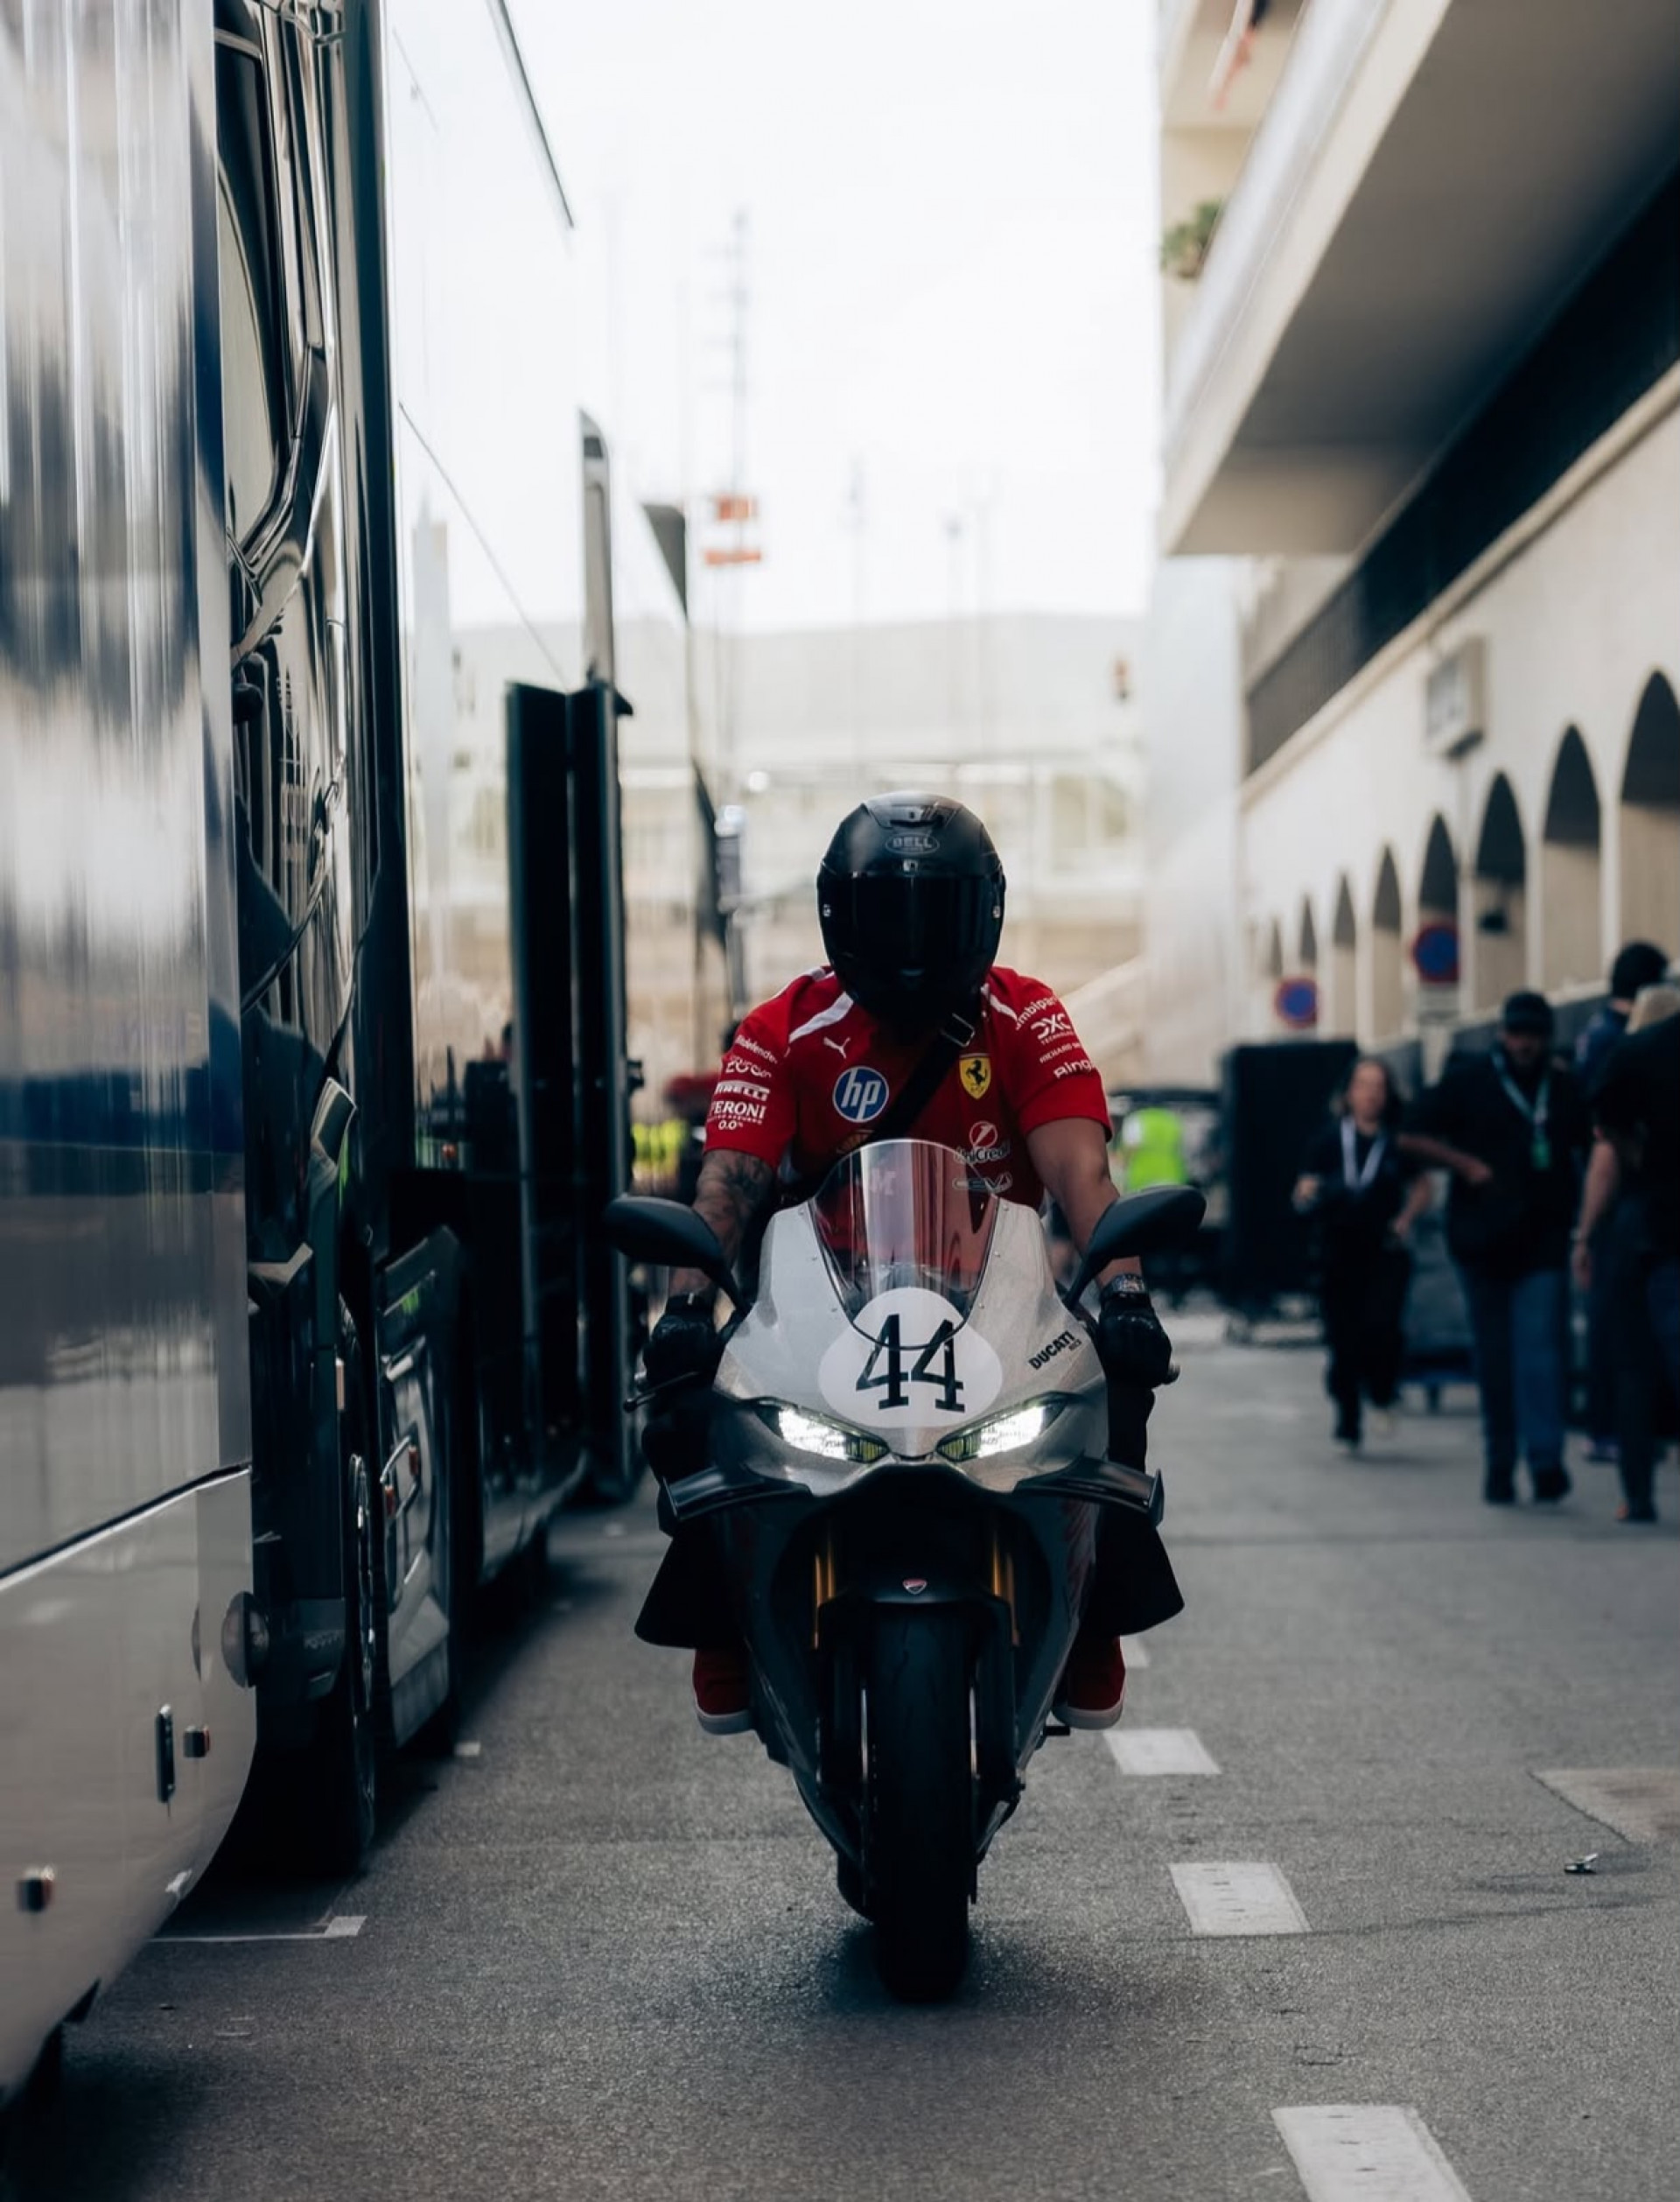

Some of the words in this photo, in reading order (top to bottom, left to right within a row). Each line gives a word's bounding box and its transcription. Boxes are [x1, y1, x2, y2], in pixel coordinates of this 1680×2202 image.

[840, 1067, 882, 1122] hp
[855, 1313, 965, 1413] 44
[1028, 1330, 1074, 1370] DUCATI
